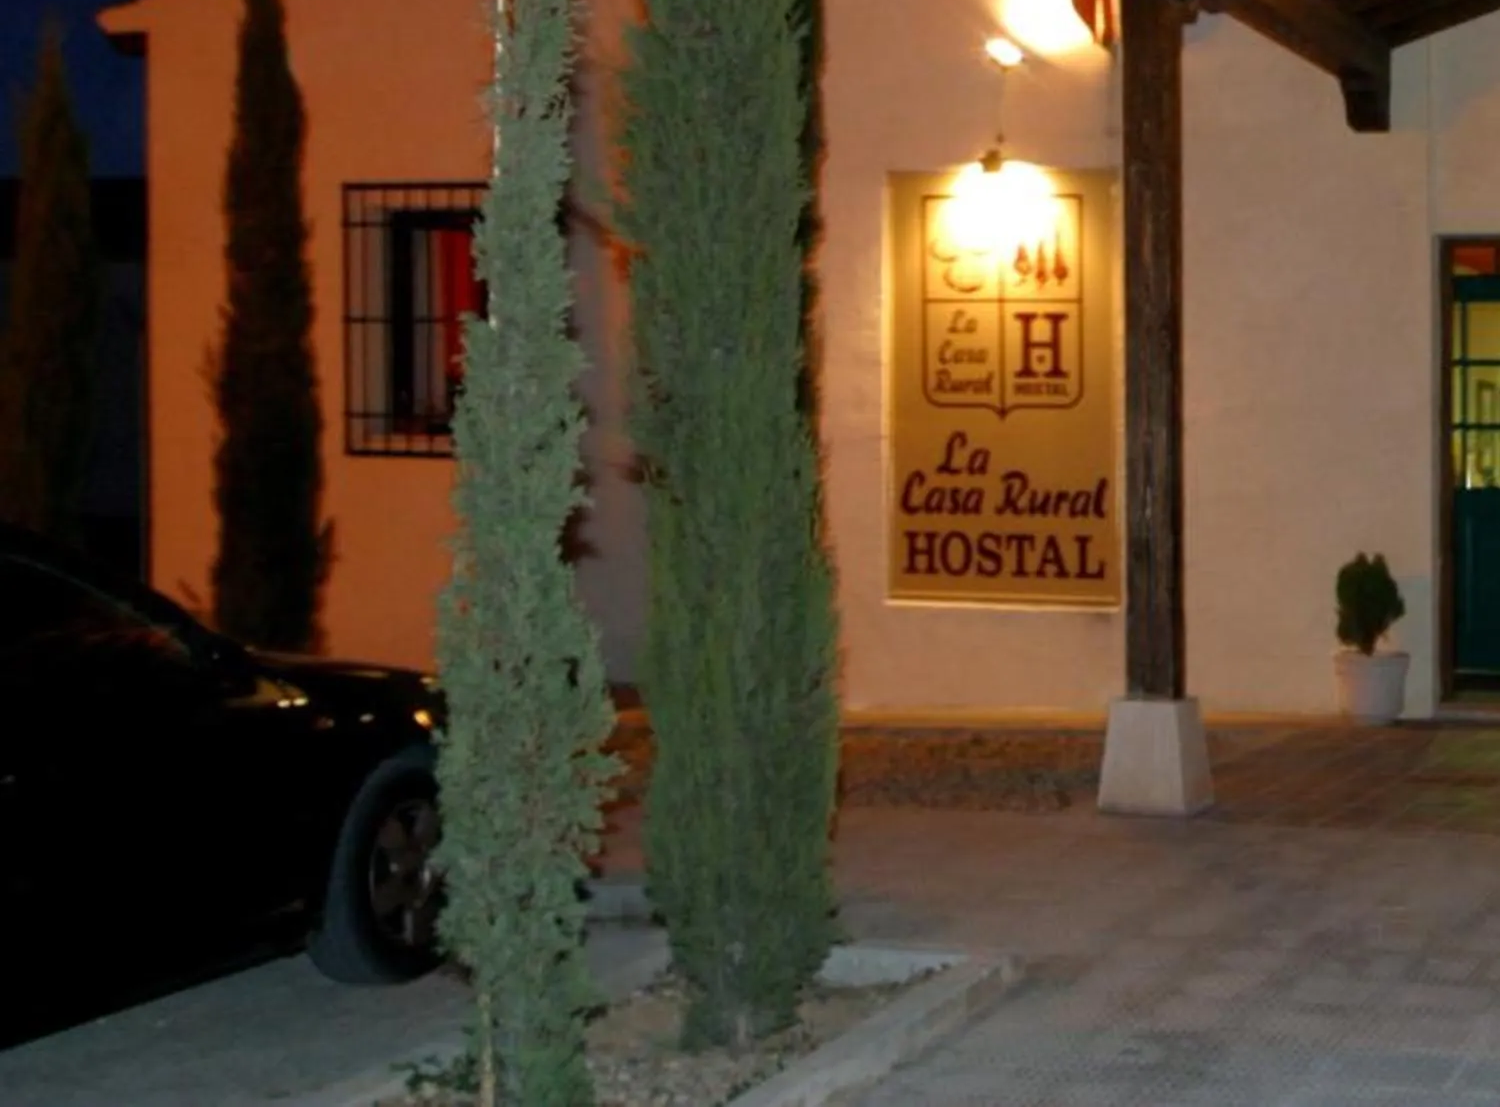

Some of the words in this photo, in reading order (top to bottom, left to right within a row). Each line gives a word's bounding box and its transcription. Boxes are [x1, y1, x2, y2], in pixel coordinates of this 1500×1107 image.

[948, 310, 978, 334] La
[938, 339, 989, 365] Casa
[1014, 312, 1070, 379] H
[934, 368, 994, 395] Rural
[936, 431, 991, 475] La
[900, 470, 986, 516] Casa
[996, 470, 1108, 519] Rural
[903, 530, 1105, 580] HOSTAL
